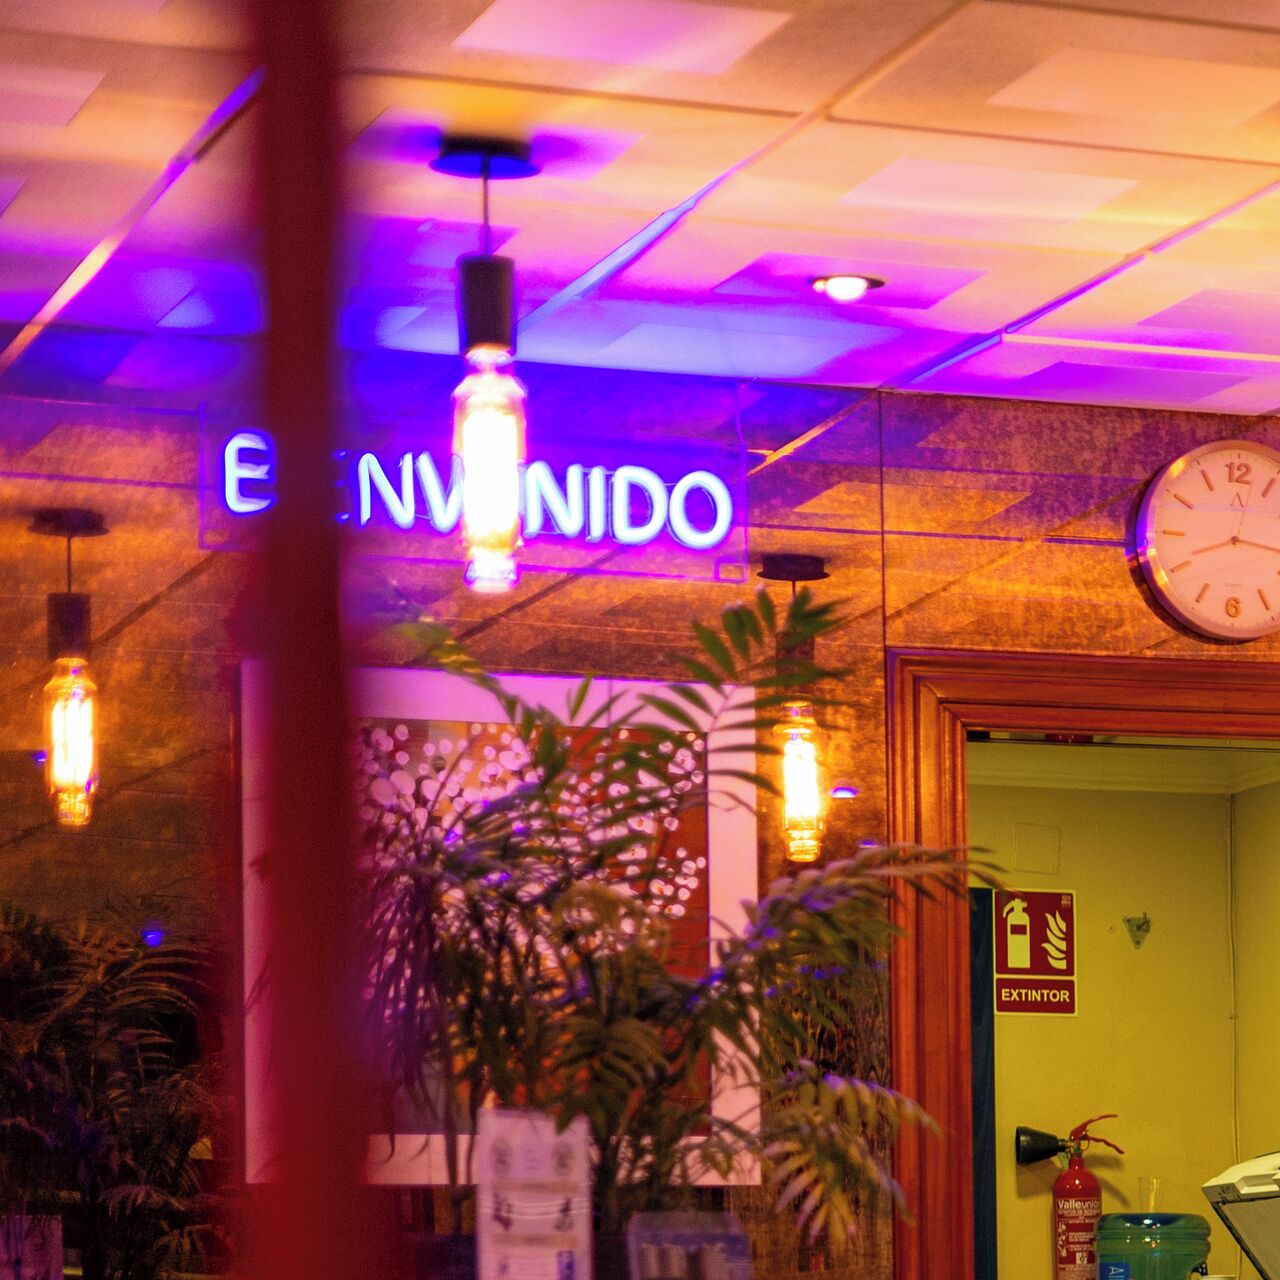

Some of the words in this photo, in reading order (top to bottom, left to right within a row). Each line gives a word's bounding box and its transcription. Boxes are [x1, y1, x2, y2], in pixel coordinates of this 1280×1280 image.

[1225, 462, 1251, 485] 12
[1225, 596, 1242, 618] 6
[1001, 988, 1070, 1002] EXTINTOR
